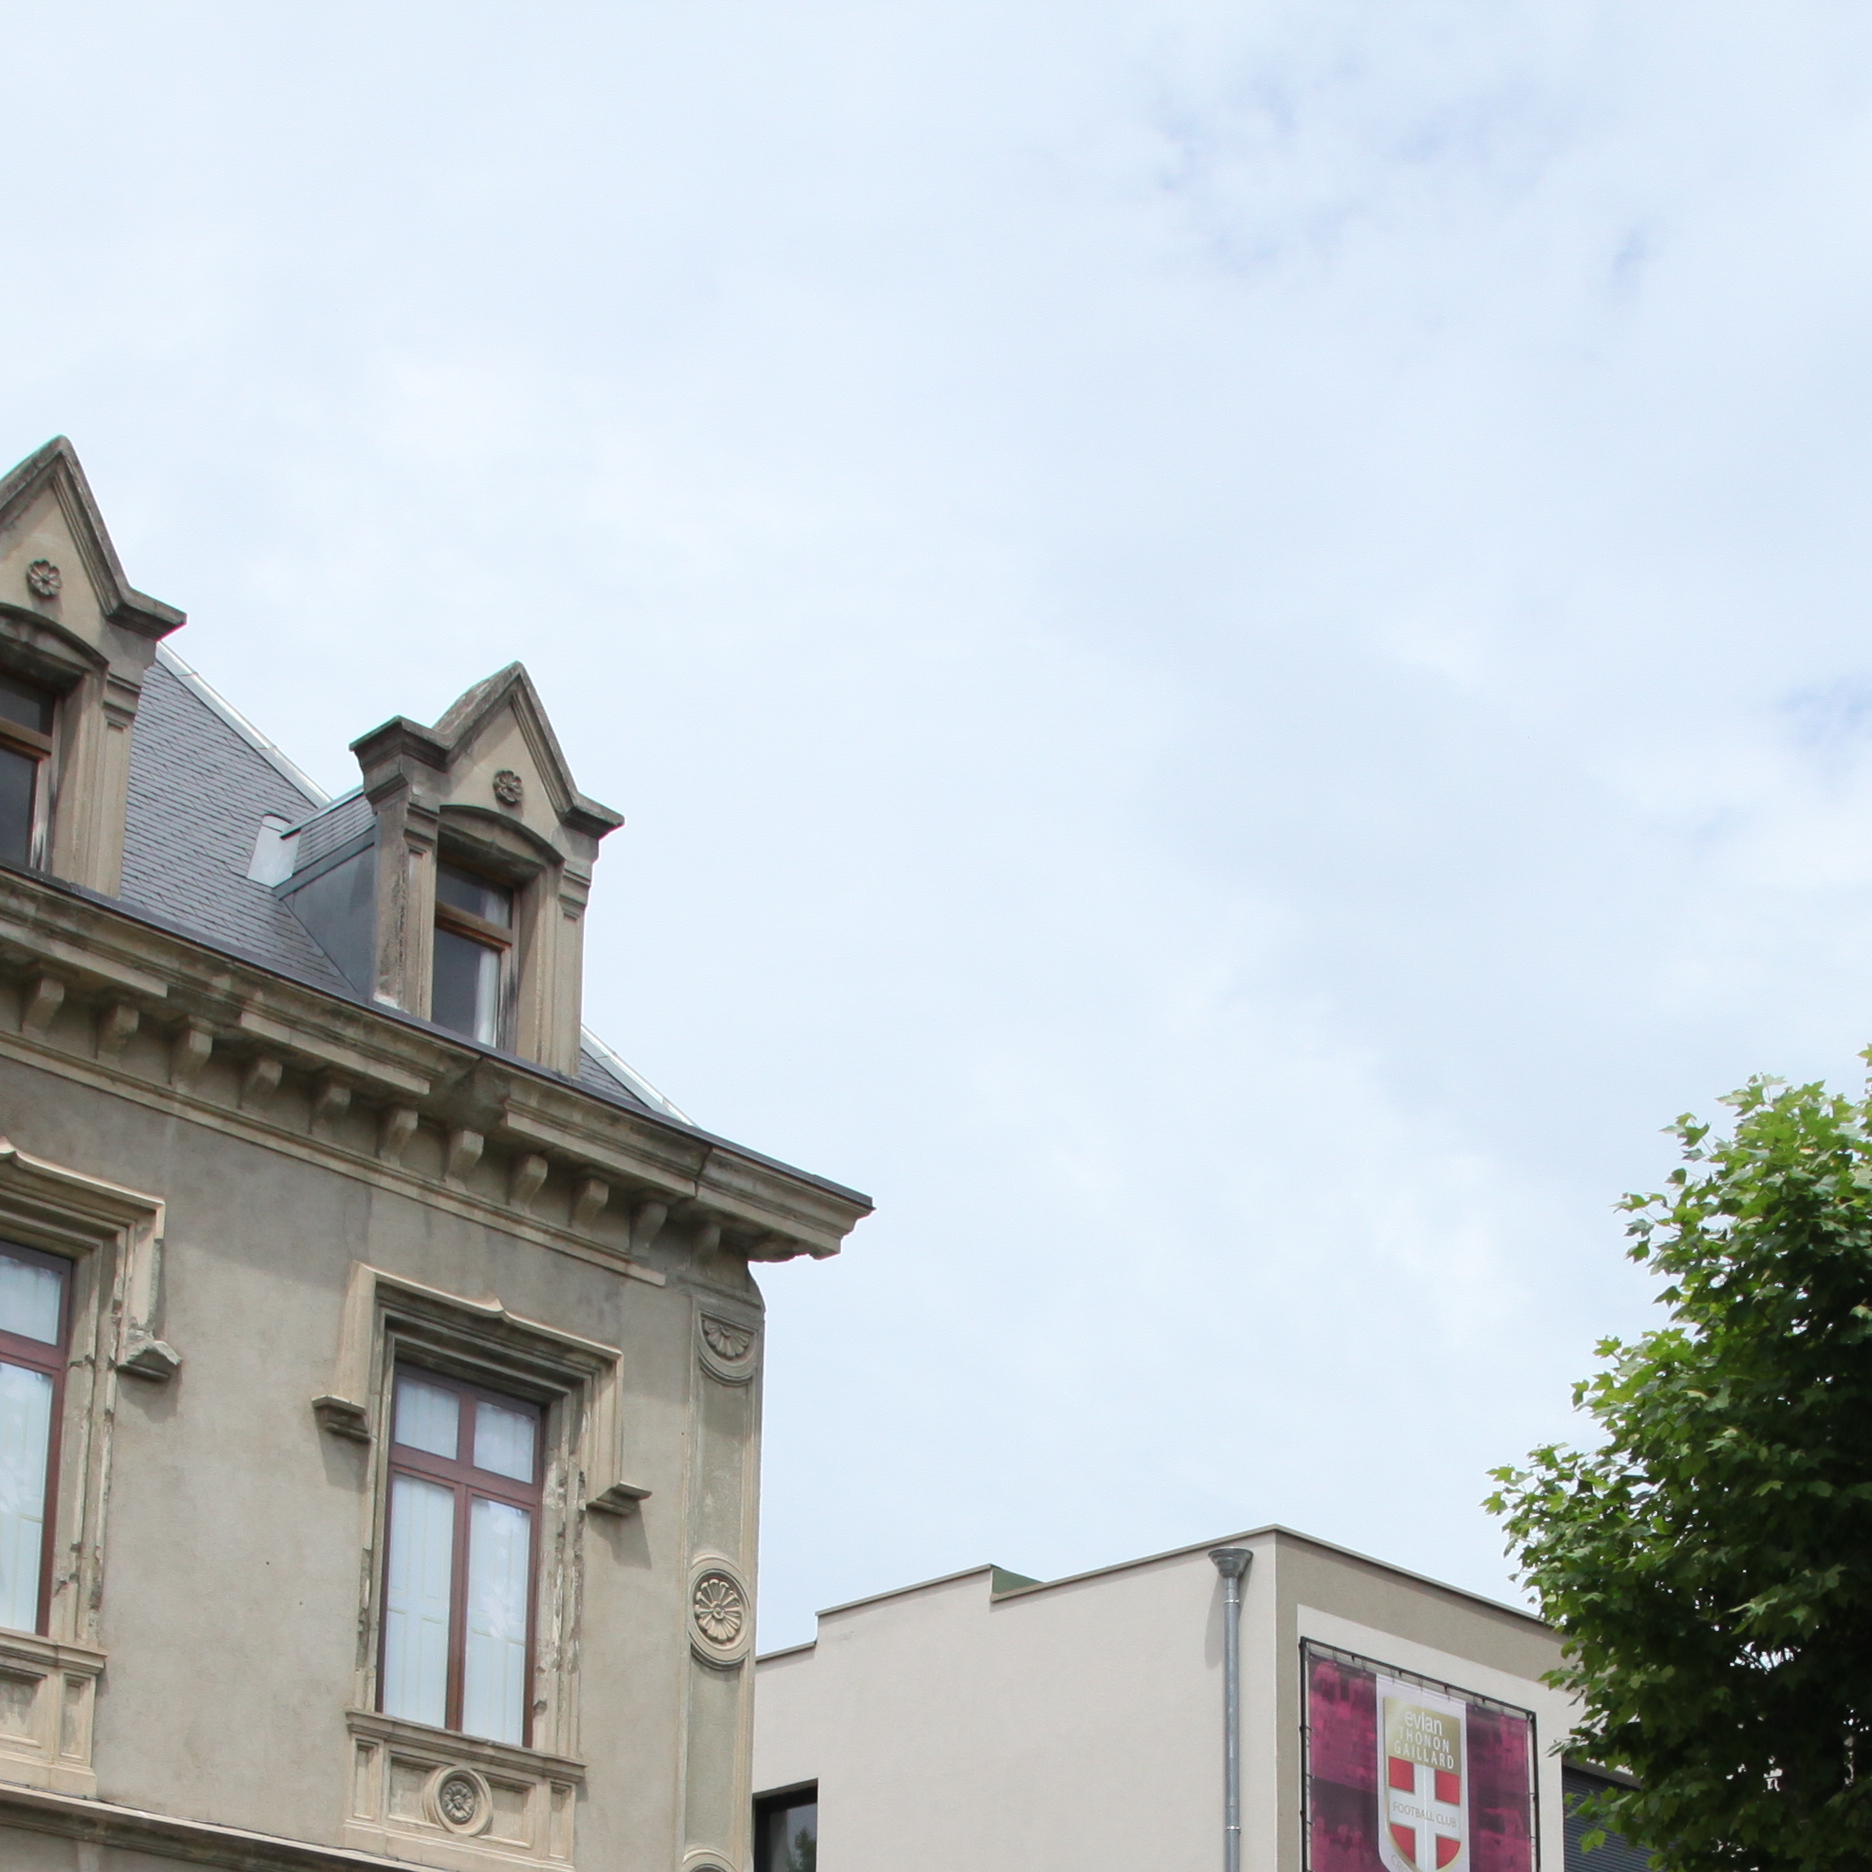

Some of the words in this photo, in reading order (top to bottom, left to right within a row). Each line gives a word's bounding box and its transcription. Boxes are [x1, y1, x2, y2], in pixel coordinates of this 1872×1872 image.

[1405, 1711, 1442, 1736] evian
[1399, 1726, 1450, 1754] THONON
[1394, 1740, 1455, 1770] GAILLARD
[1392, 1801, 1435, 1822] FOOTBALL
[1436, 1813, 1457, 1828] CLUB
